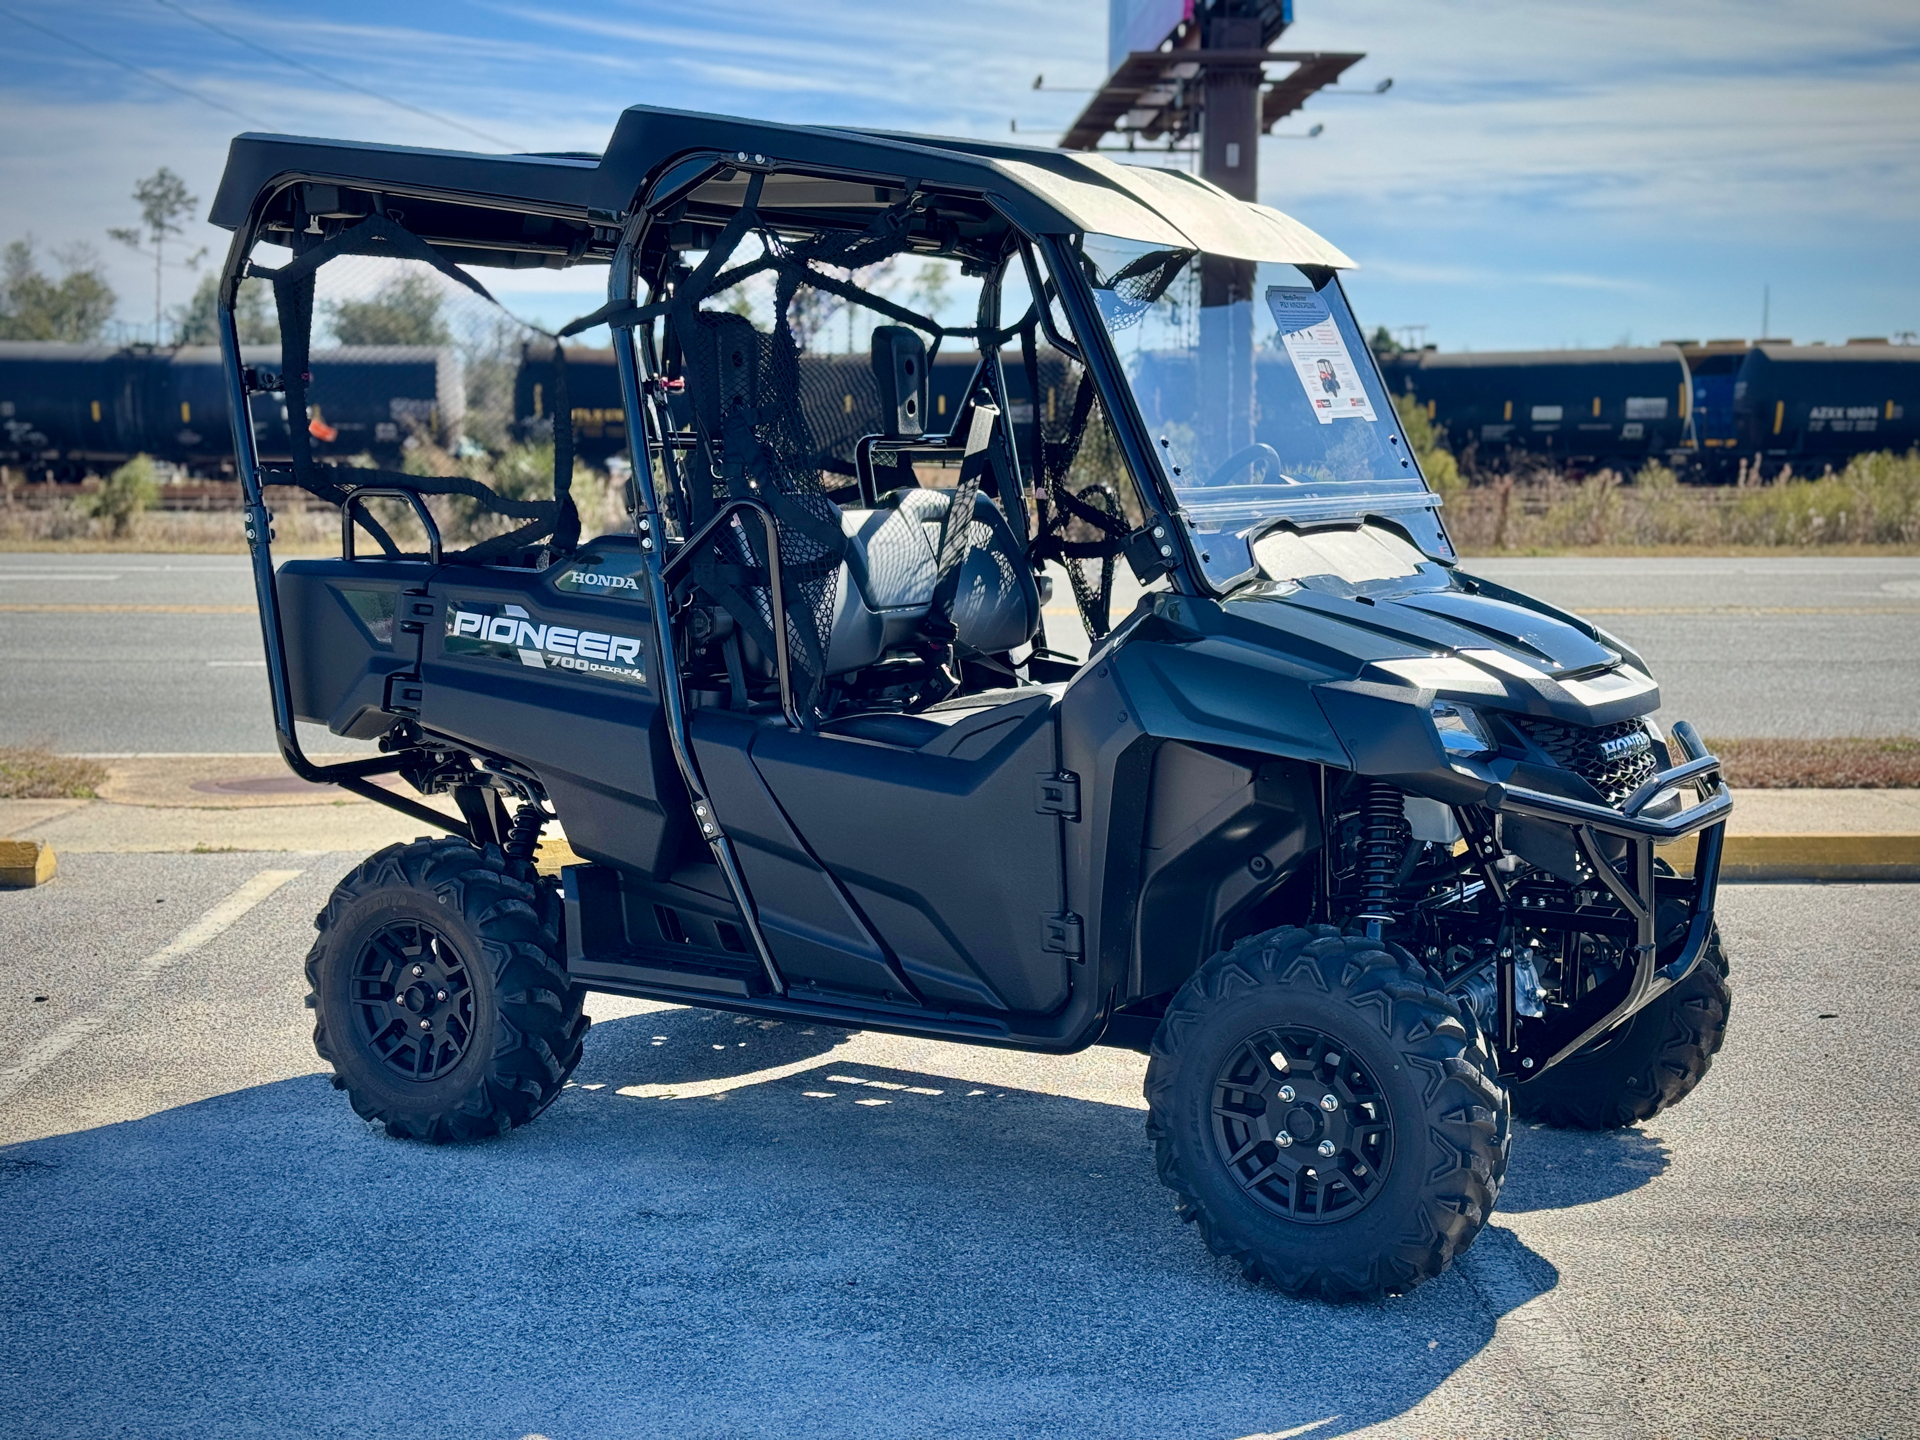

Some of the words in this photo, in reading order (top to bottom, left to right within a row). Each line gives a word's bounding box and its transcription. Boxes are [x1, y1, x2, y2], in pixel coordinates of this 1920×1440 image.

[570, 571, 639, 590] HONDA
[453, 610, 641, 665] PIONEER
[547, 654, 590, 672] 700
[1601, 731, 1651, 753] HONDA
